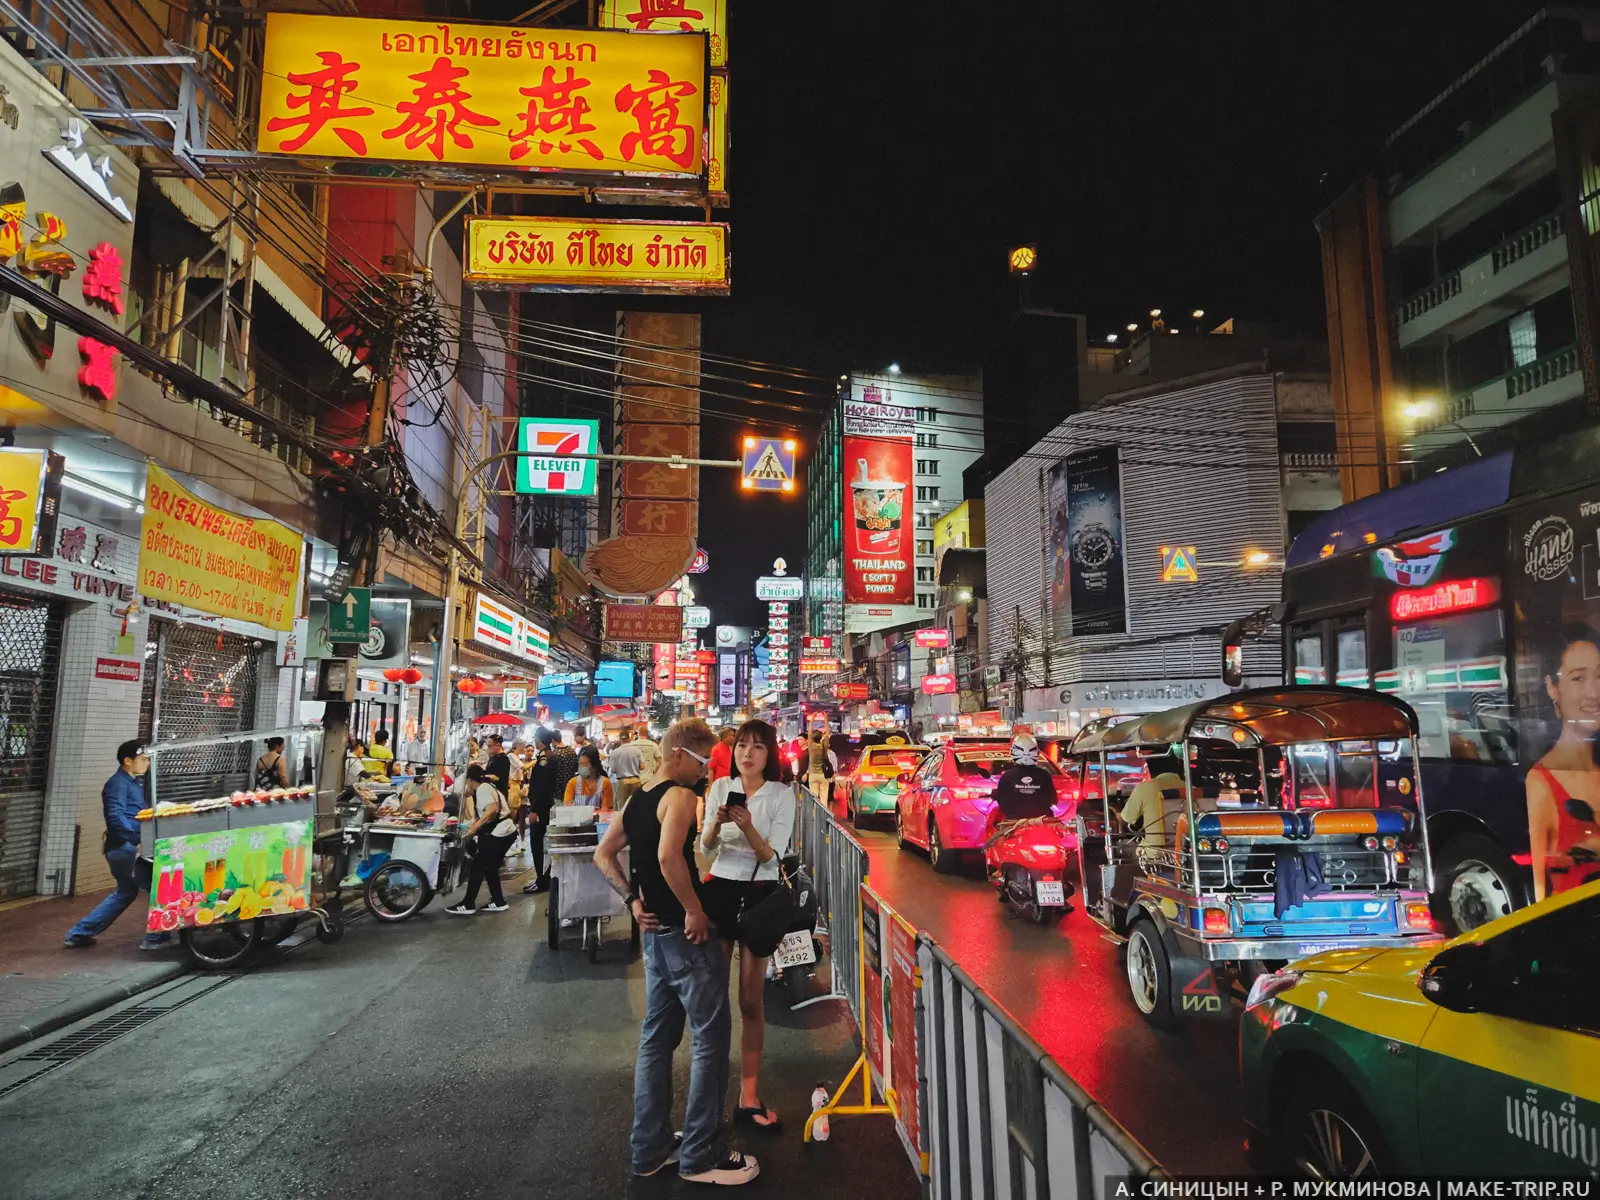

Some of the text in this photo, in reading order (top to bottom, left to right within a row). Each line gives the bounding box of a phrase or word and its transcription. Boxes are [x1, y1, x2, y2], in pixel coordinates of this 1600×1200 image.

[382, 25, 597, 62] เอกไทยรังนก
[487, 231, 553, 267] บริษัท
[645, 234, 707, 268] จำกัด
[2, 556, 58, 584] LEE
[71, 571, 134, 600] THYE
[852, 558, 906, 570] THAILAND
[1532, 551, 1574, 582] TOSSED
[865, 584, 894, 593] POWER
[783, 952, 809, 964] 2492
